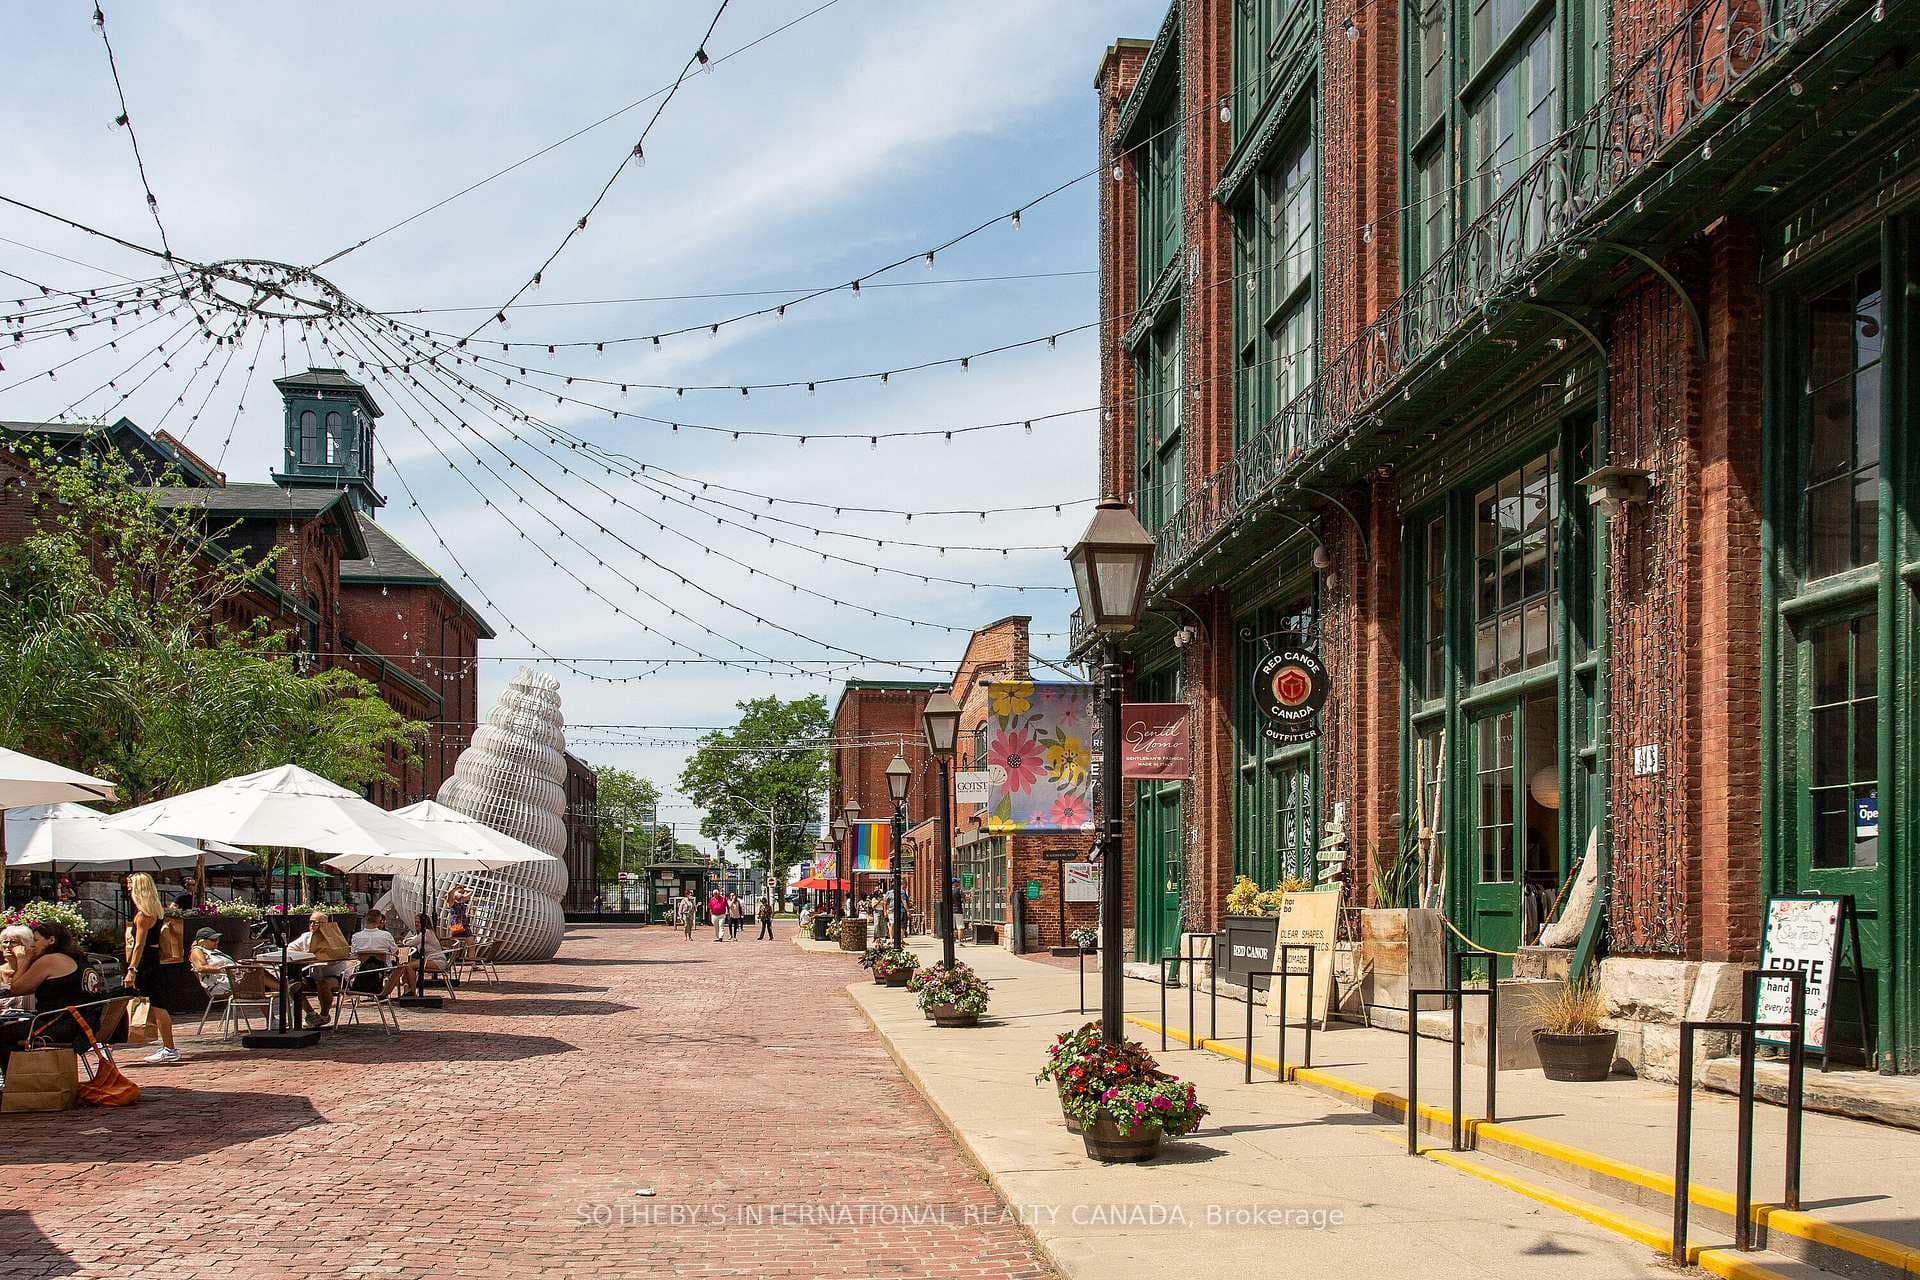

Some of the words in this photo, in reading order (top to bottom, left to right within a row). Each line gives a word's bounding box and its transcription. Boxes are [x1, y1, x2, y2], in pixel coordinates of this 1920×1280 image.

[1262, 655, 1282, 675] RED
[1284, 652, 1320, 674] CANOE
[1271, 706, 1314, 719] CANADA
[1266, 729, 1317, 741] OUTFITTER
[1132, 737, 1184, 753] Uomo
[1280, 930, 1299, 939] CLEAR
[1233, 944, 1245, 956] RED
[1767, 981, 1789, 992] hand
[1764, 1003, 1783, 1014] every
